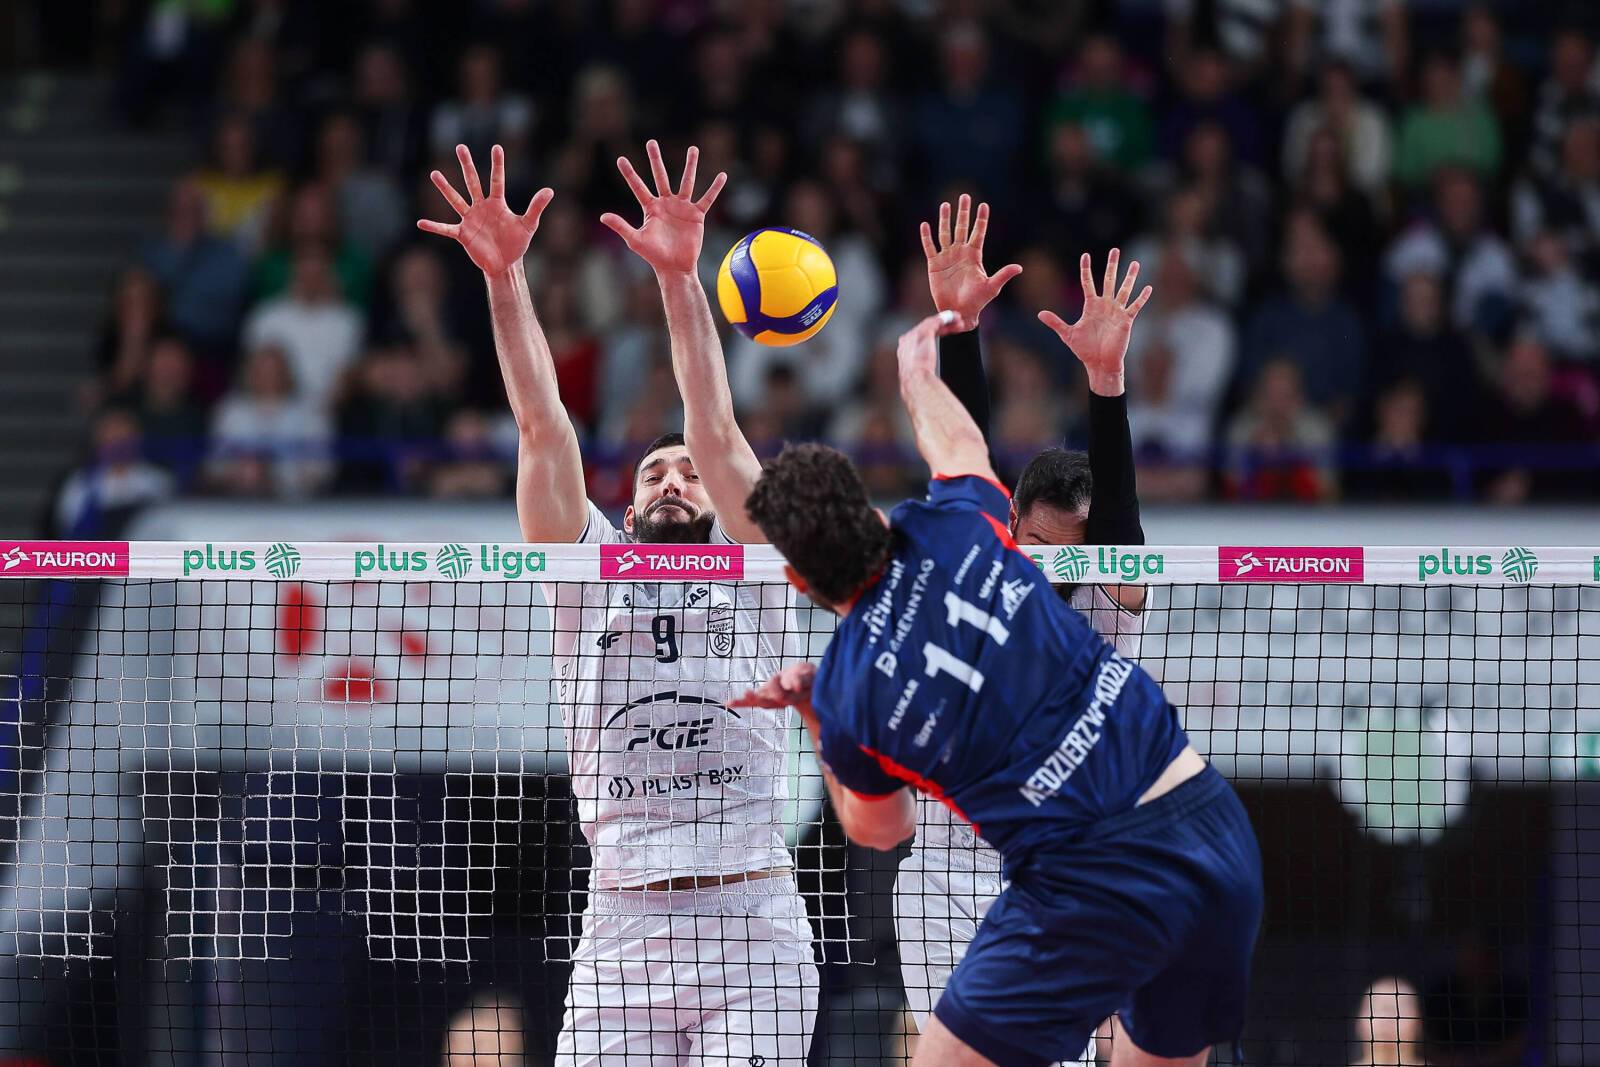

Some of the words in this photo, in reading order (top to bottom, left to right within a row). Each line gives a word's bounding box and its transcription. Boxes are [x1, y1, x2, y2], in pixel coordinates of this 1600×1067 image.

[32, 552, 116, 567] TAURON
[184, 544, 256, 576] plus
[355, 544, 427, 576] plus
[480, 545, 546, 578] liga
[646, 555, 730, 570] TAURON
[1098, 548, 1164, 581] liga
[1265, 557, 1349, 573] TAURON
[1418, 548, 1493, 581] plus
[652, 614, 679, 663] 9
[922, 591, 1010, 693] 11
[627, 717, 714, 751] PGE
[642, 771, 702, 795] PLAST
[708, 765, 744, 785] BOX
